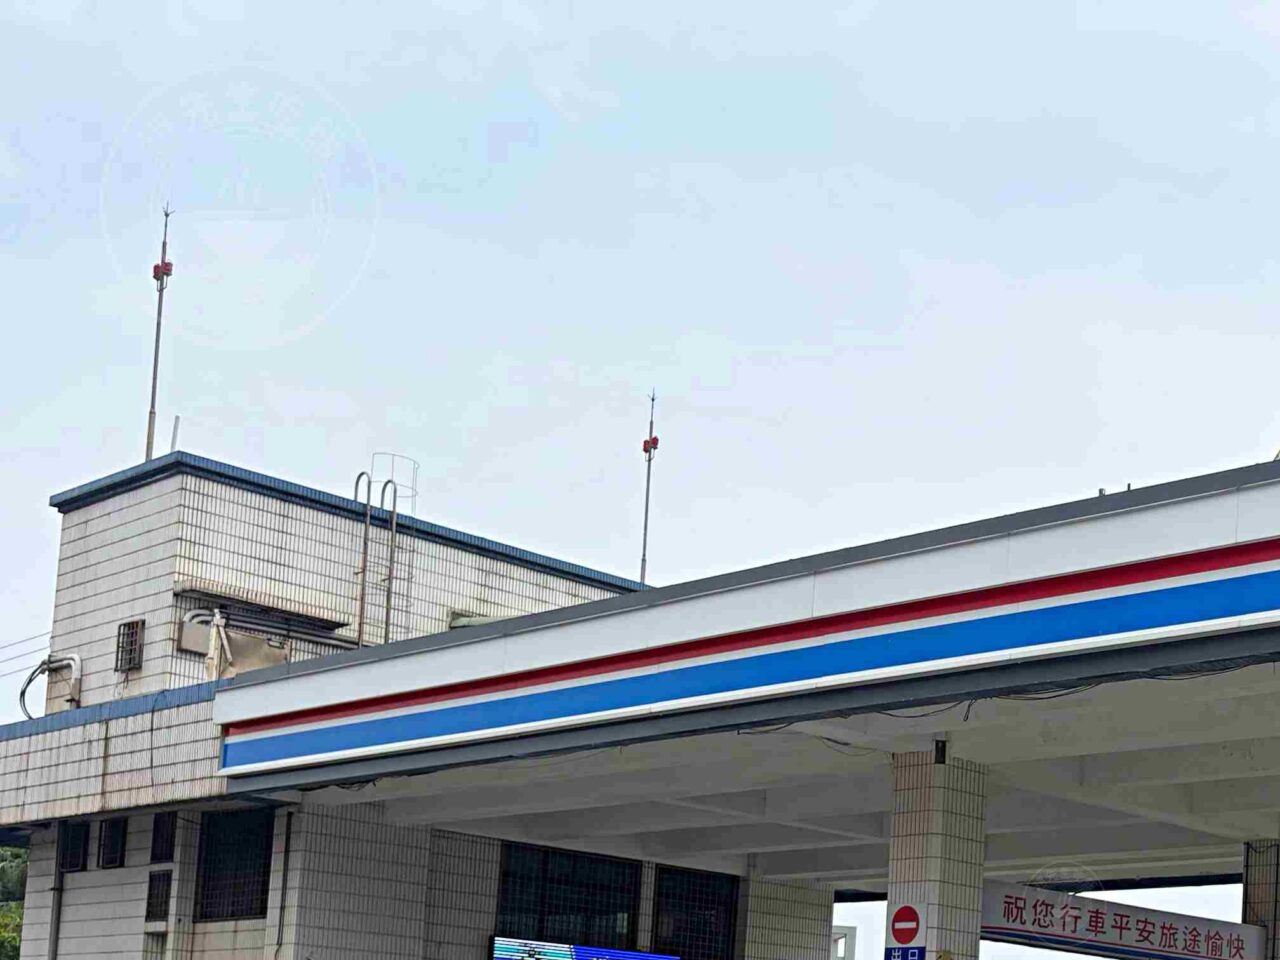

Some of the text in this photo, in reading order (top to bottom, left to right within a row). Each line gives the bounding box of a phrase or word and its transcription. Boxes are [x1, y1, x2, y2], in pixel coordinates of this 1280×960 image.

[1002, 893, 1247, 960] 祝您行車平安旅途愉快
[890, 948, 920, 960] 出口
